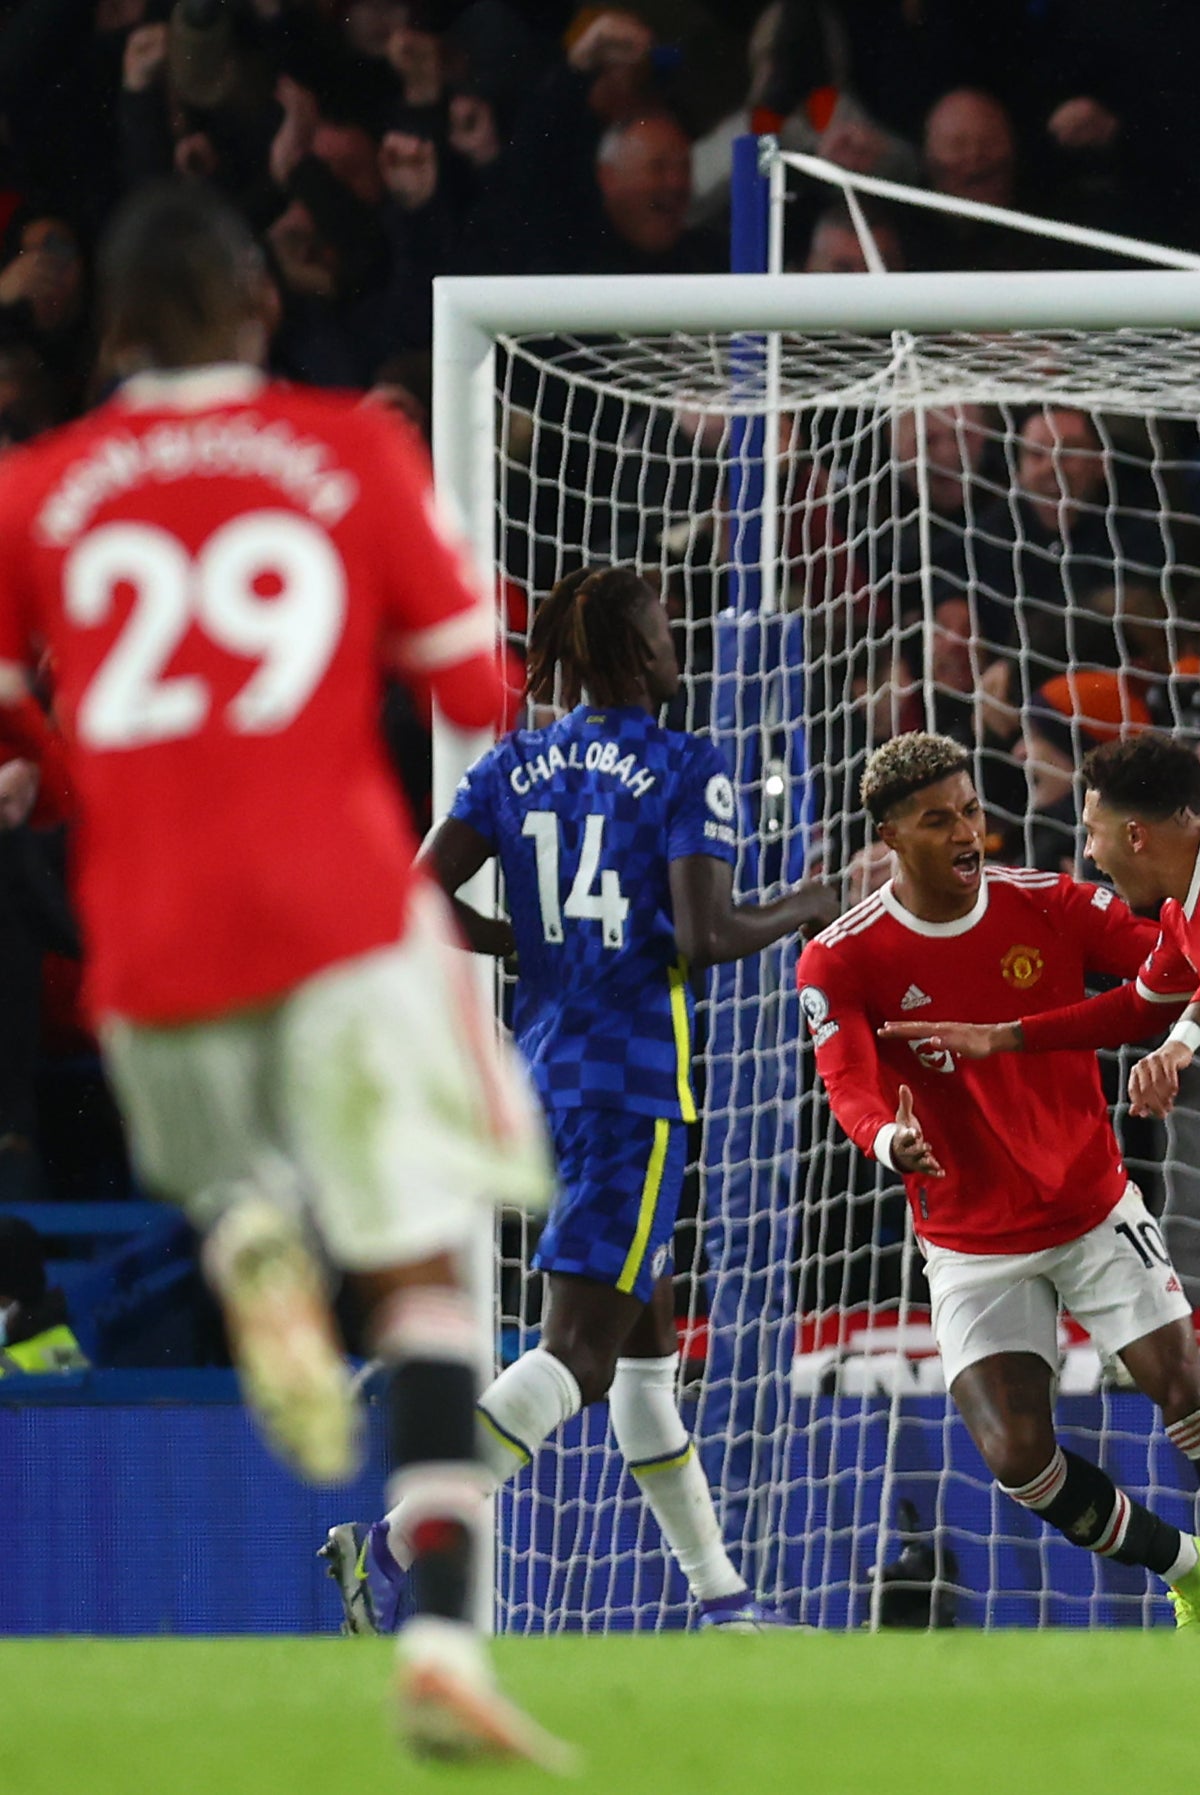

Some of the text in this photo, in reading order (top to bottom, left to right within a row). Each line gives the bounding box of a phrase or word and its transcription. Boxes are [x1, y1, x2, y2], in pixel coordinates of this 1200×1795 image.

[66, 509, 347, 750] 29
[510, 741, 656, 799] CHALOBAH
[521, 810, 630, 949] 14
